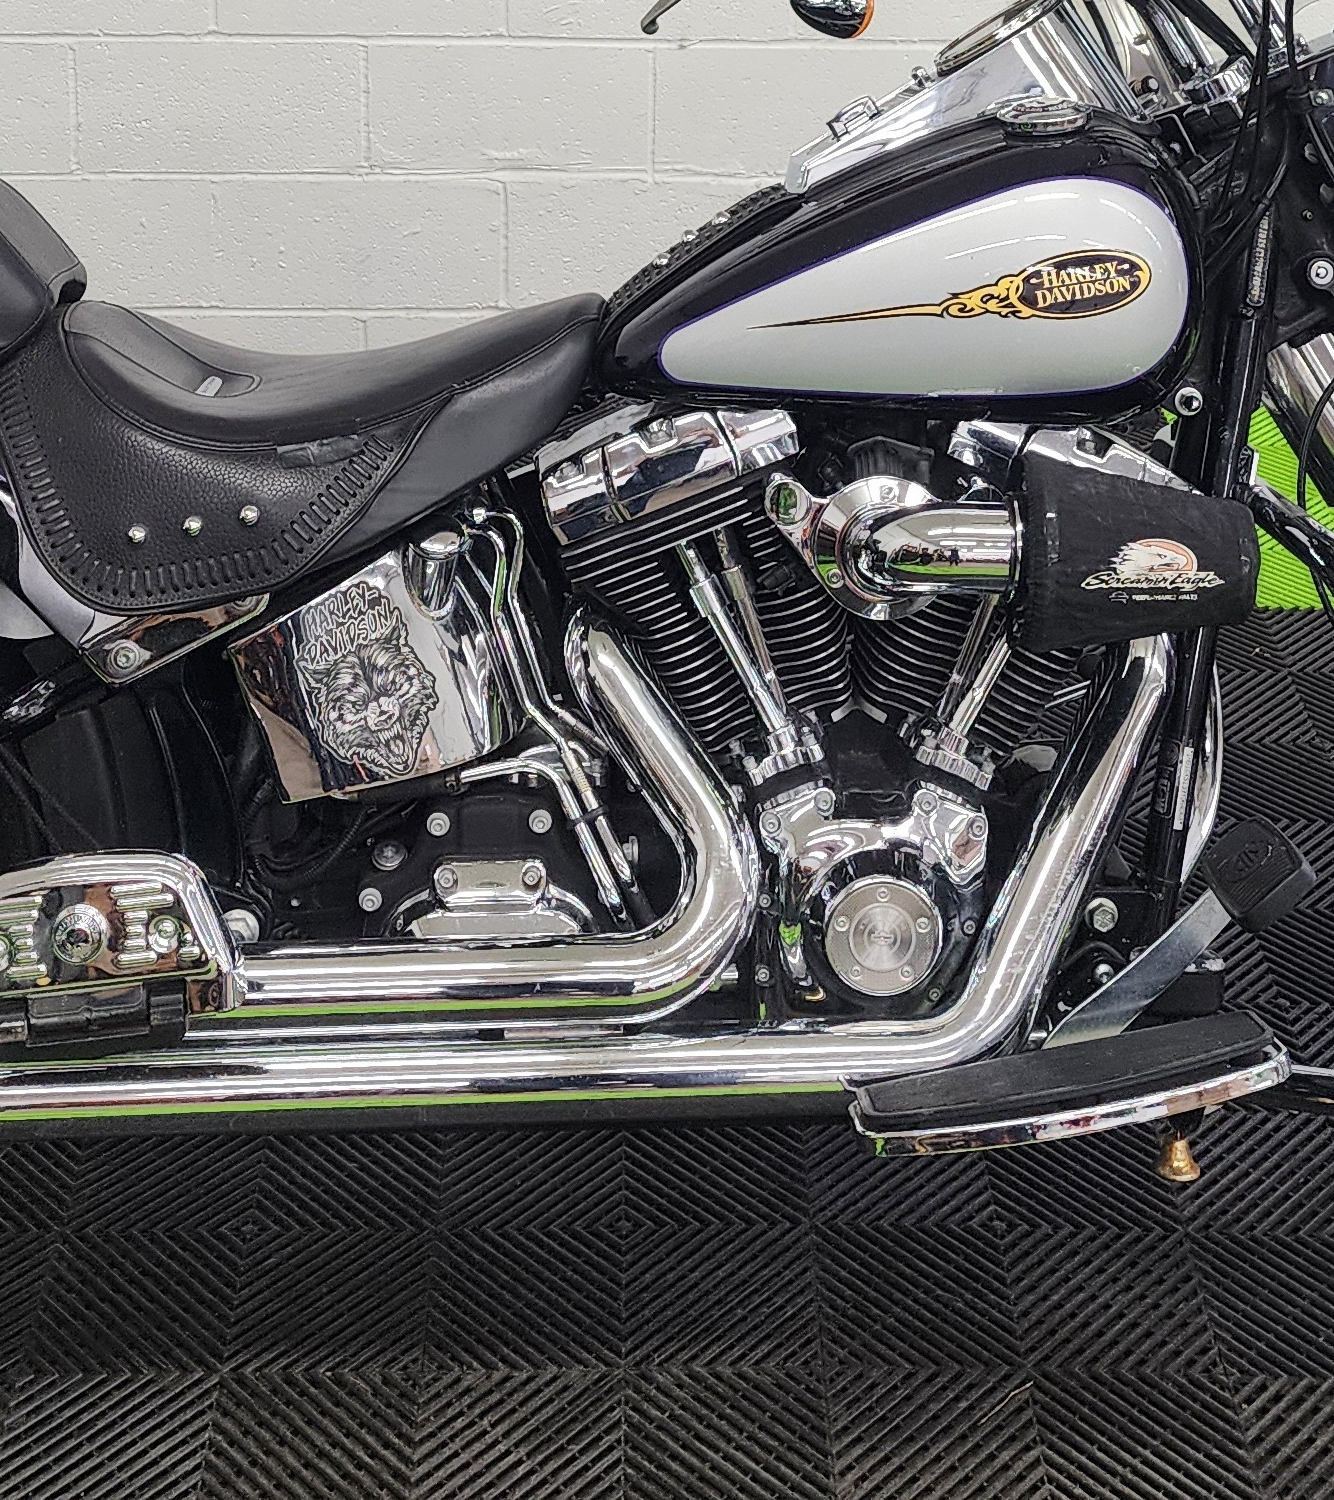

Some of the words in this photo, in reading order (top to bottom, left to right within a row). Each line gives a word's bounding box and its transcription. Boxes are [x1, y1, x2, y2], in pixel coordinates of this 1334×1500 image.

[1040, 261, 1118, 288] HARLEY
[1034, 275, 1131, 308] DAVIDSON
[303, 598, 392, 668] DAVIDSON
